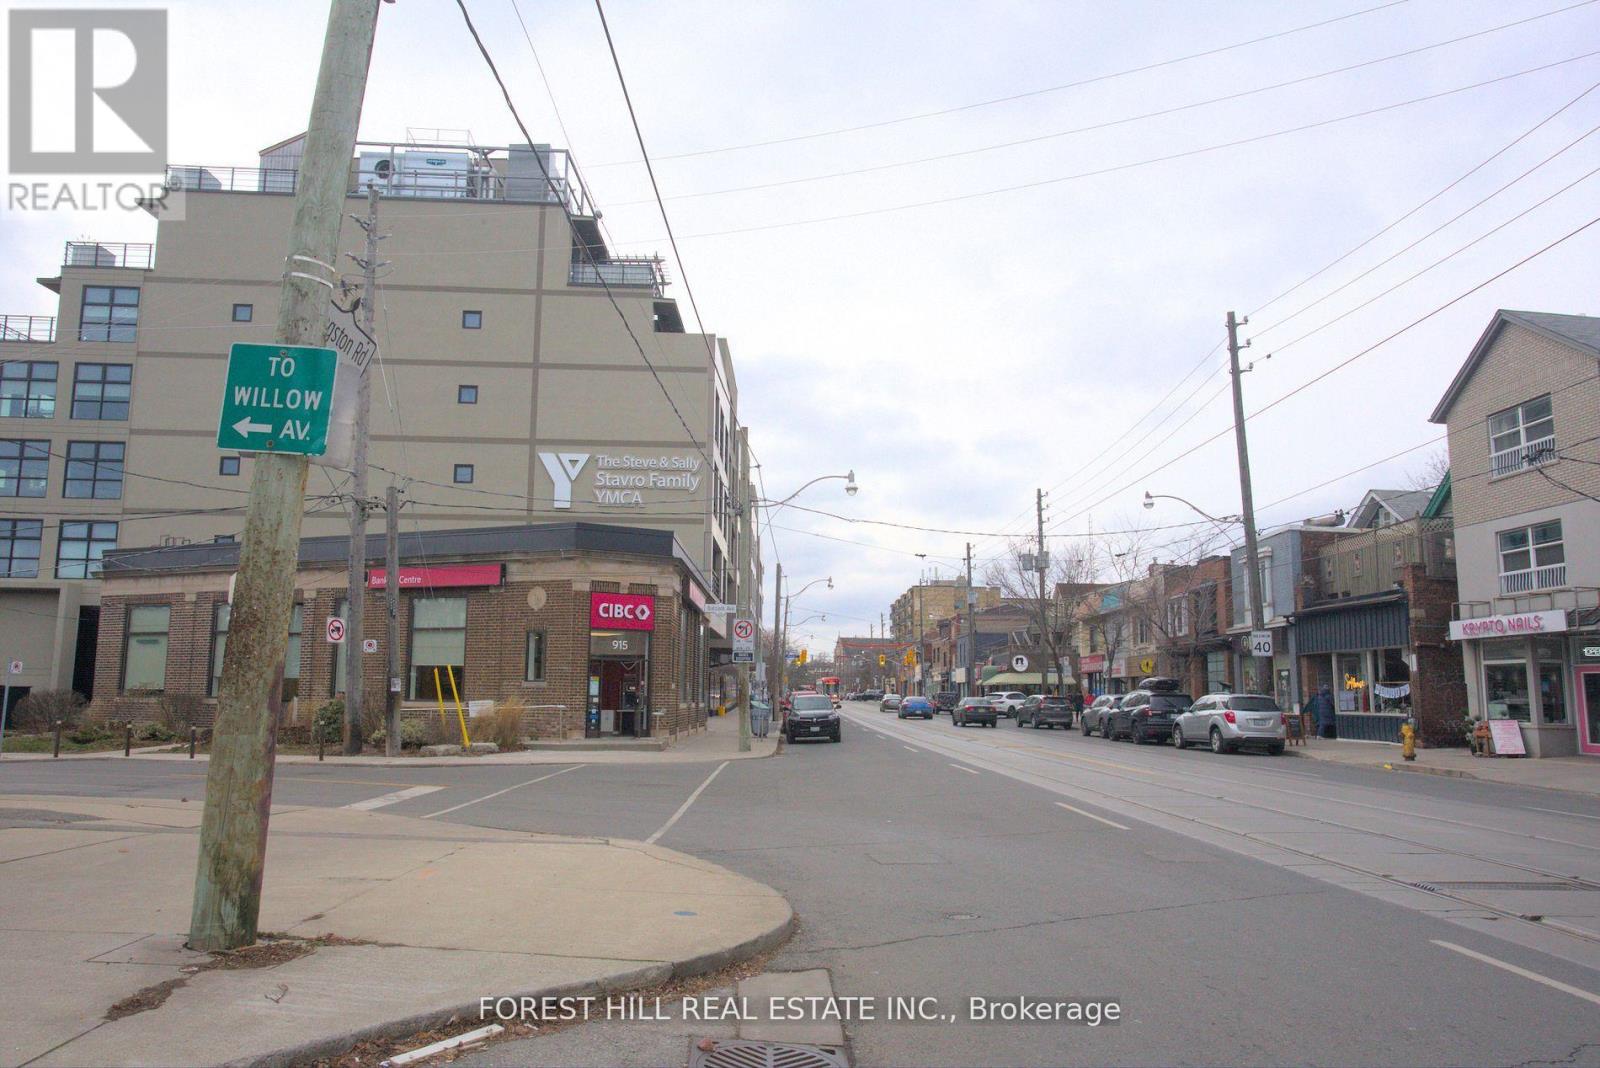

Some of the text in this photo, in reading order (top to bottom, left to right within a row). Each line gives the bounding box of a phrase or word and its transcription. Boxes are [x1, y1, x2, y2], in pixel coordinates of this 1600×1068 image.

[325, 321, 370, 367] gston Rd
[268, 356, 296, 378] TO
[234, 385, 323, 411] WILLOW
[279, 419, 311, 441] AV.
[596, 455, 701, 473] The Steve & Sally
[594, 472, 701, 495] Stavro Family
[594, 488, 643, 505] YMCA
[398, 575, 422, 585] Centre
[598, 602, 635, 619] CIBC
[1461, 615, 1544, 635] KRYPTO NAILS
[611, 639, 629, 650] 915
[1253, 641, 1271, 653] 40
